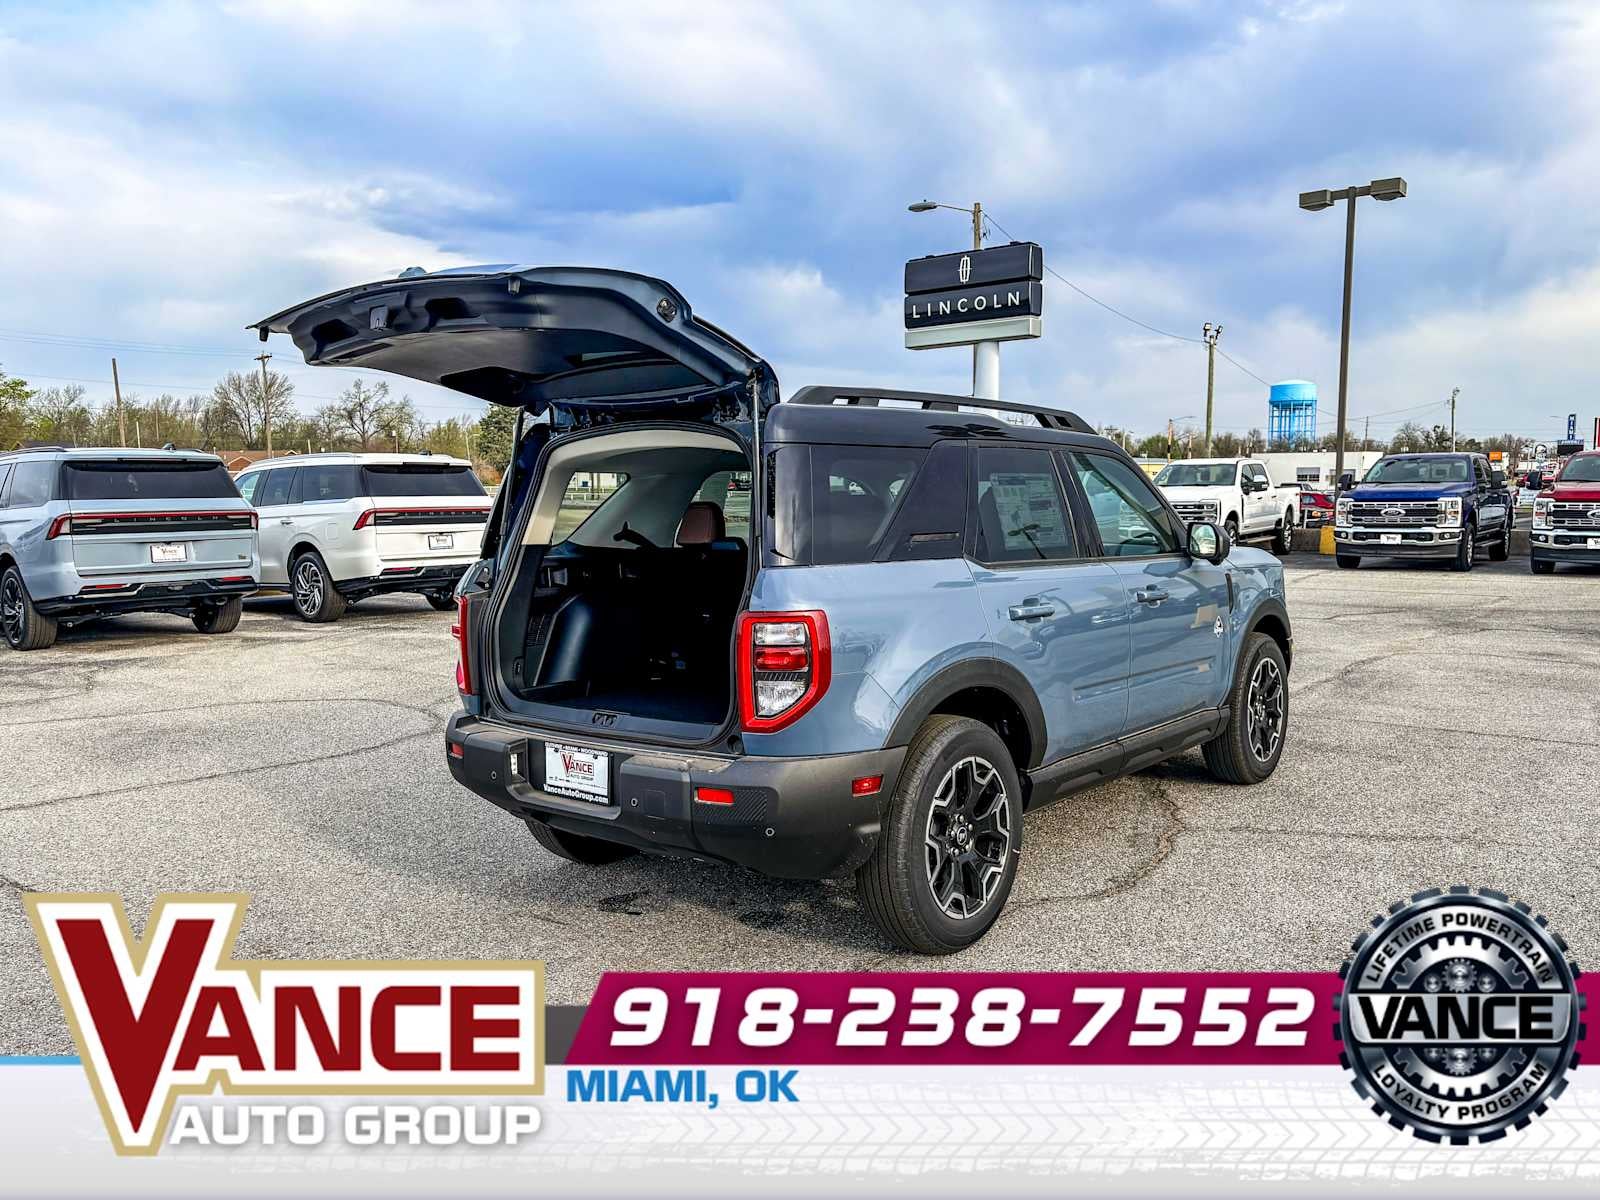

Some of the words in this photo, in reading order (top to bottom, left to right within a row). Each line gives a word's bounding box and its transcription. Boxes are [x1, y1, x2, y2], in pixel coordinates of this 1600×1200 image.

[912, 291, 1020, 318] LINCOLN
[561, 752, 593, 776] VANCE
[544, 784, 608, 804] VanceAutoGroup.com
